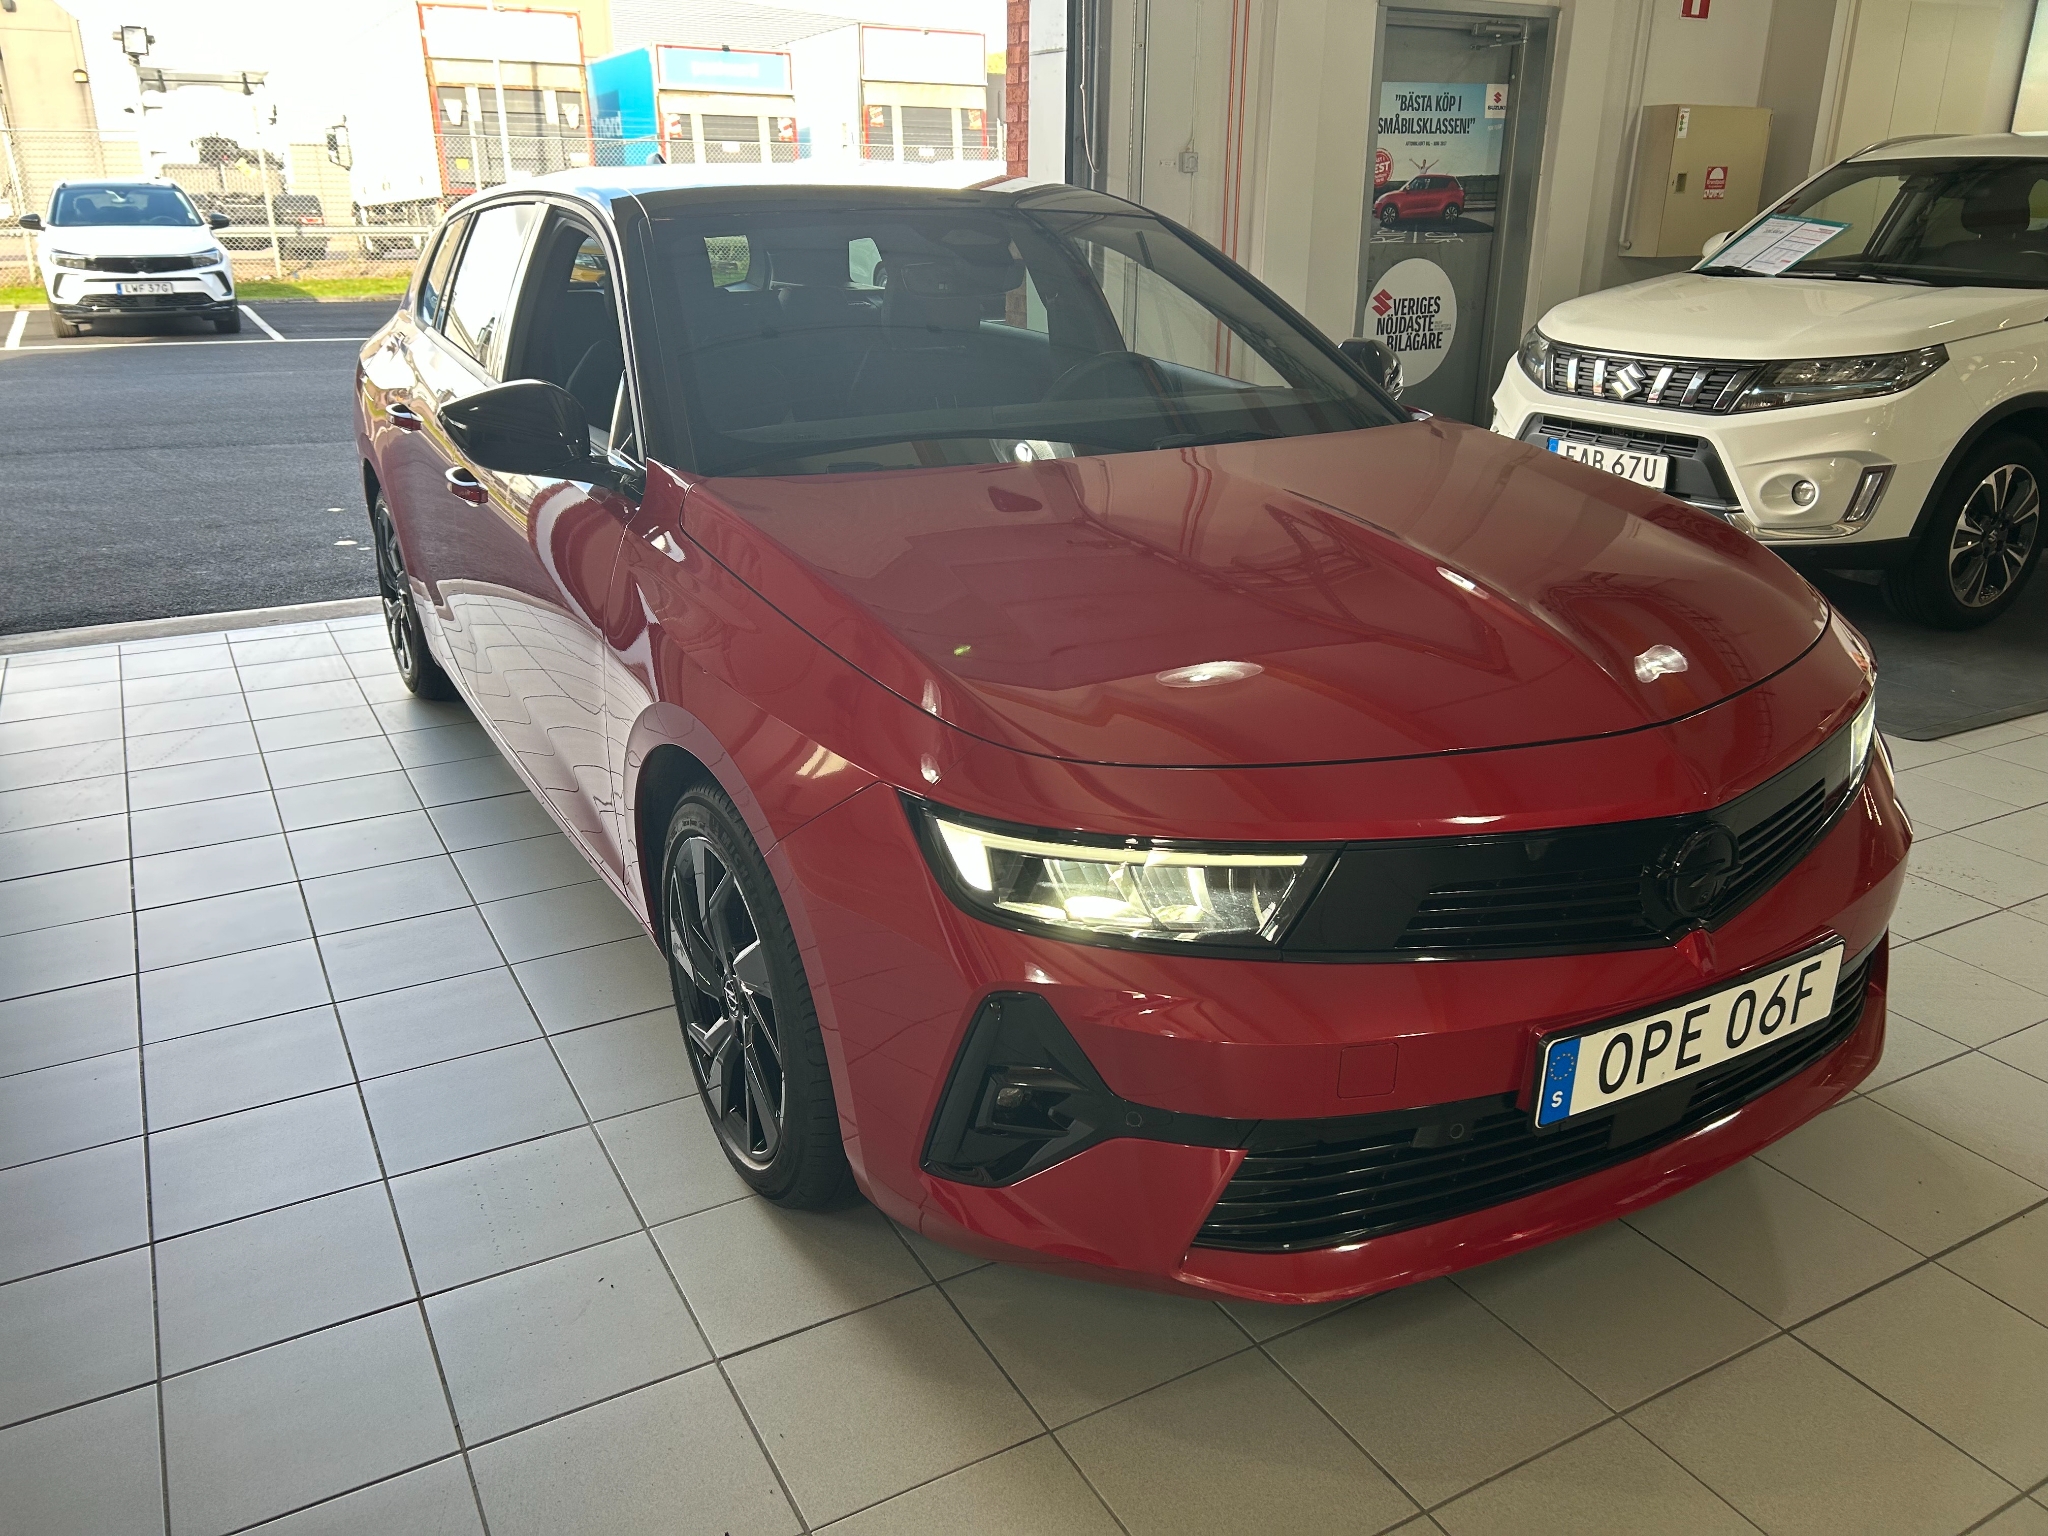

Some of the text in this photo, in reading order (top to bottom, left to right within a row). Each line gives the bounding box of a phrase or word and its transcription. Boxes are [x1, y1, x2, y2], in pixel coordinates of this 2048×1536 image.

[1435, 92, 1456, 112] KÖP
[1458, 96, 1462, 112] I
[124, 284, 144, 293] LWF
[1376, 314, 1435, 335] NÖJDASTE
[1387, 332, 1443, 352] BILÄGARE
[1612, 454, 1657, 482] 67U
[1599, 960, 1823, 1095] OPE 06F
[1551, 1090, 1564, 1108] S
